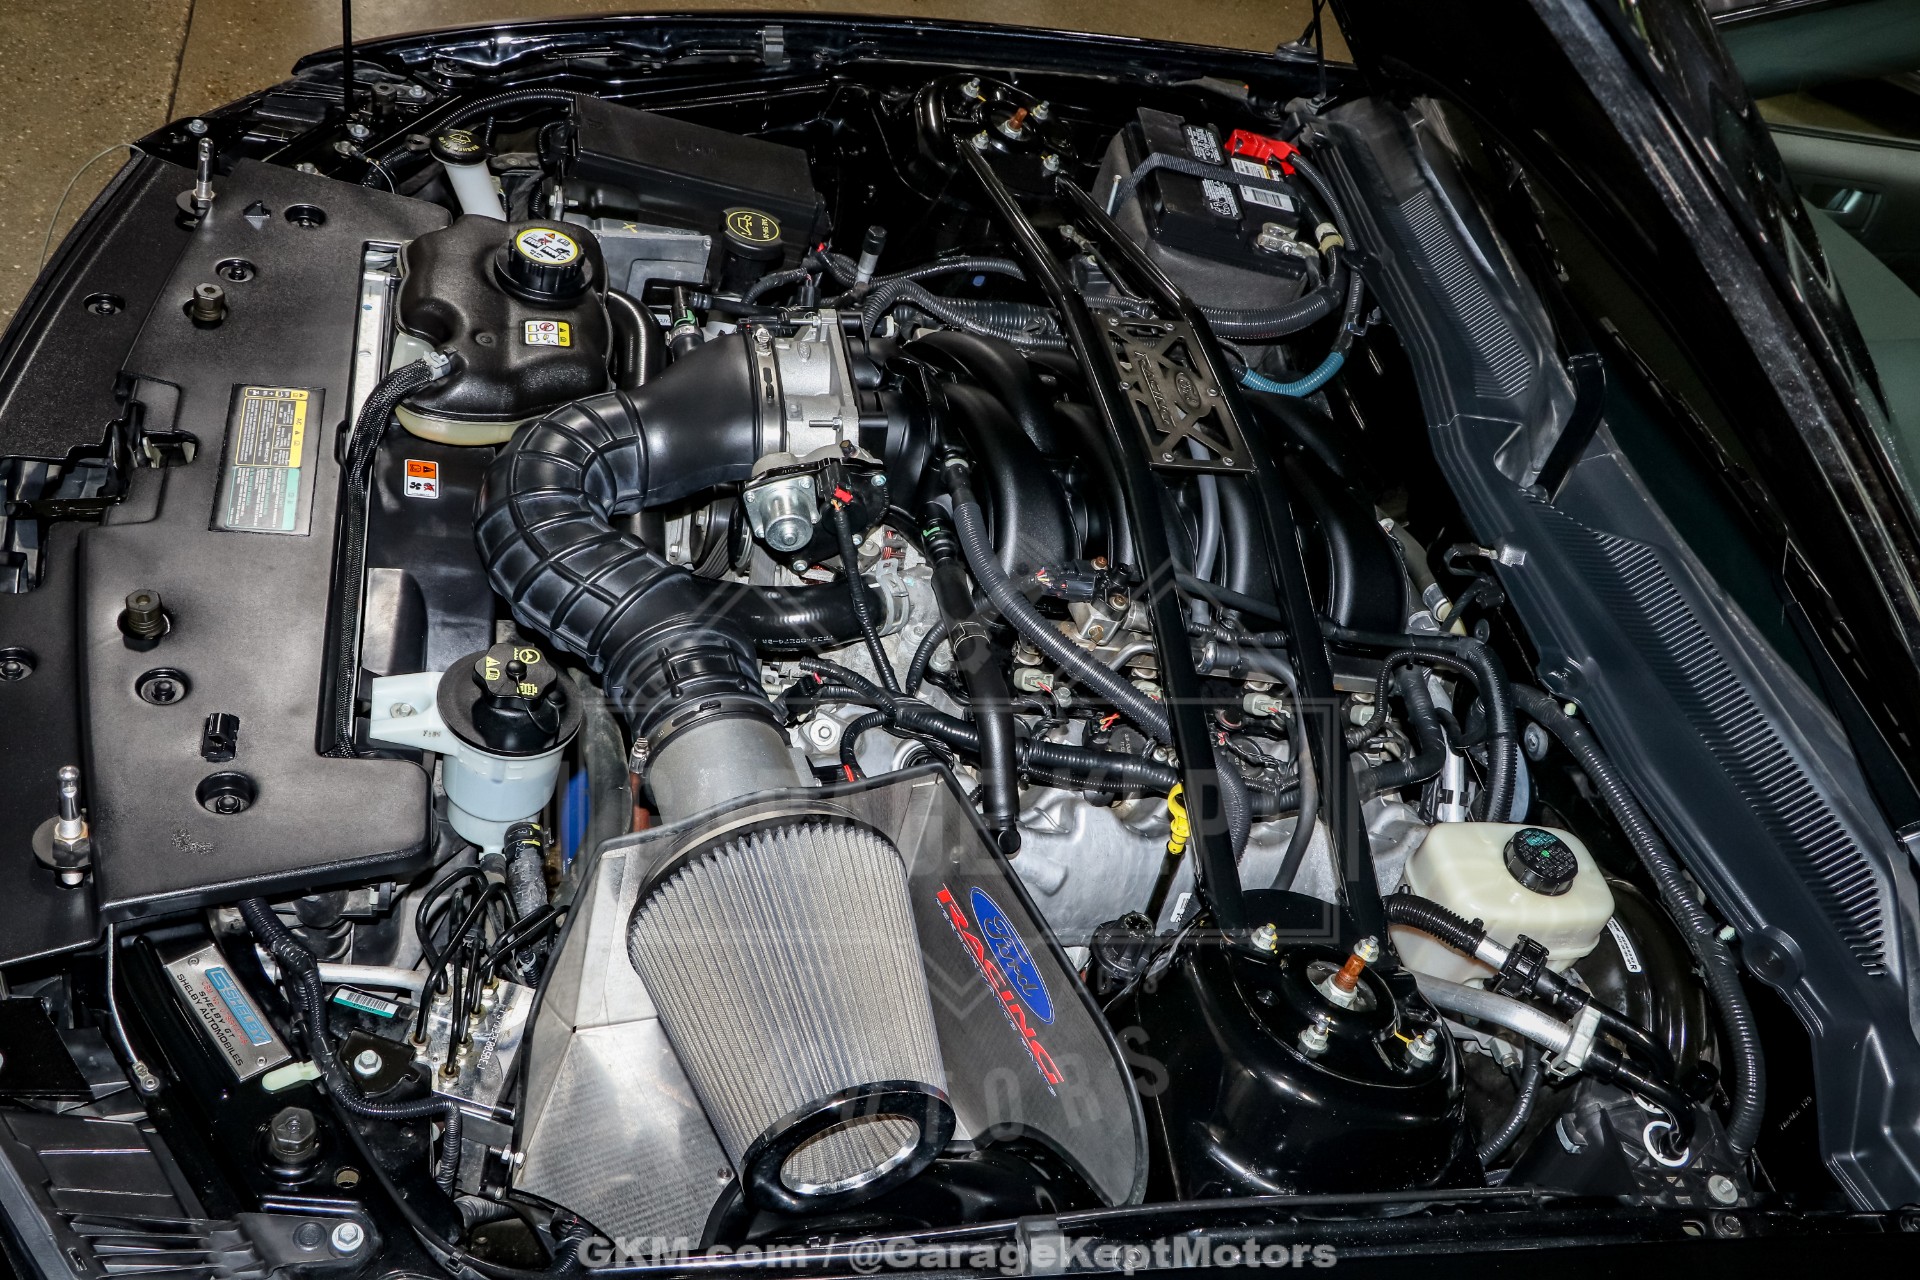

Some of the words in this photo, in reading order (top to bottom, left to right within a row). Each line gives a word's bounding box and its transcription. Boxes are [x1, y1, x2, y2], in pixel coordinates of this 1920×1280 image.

[936, 883, 1065, 1086] RACING
[982, 913, 1039, 999] Ford
[176, 974, 203, 1004] SHELBY
[199, 1008, 244, 1066] AUTOMOBILES
[198, 990, 225, 1025] SHELBY
[225, 1028, 236, 1038] GT
